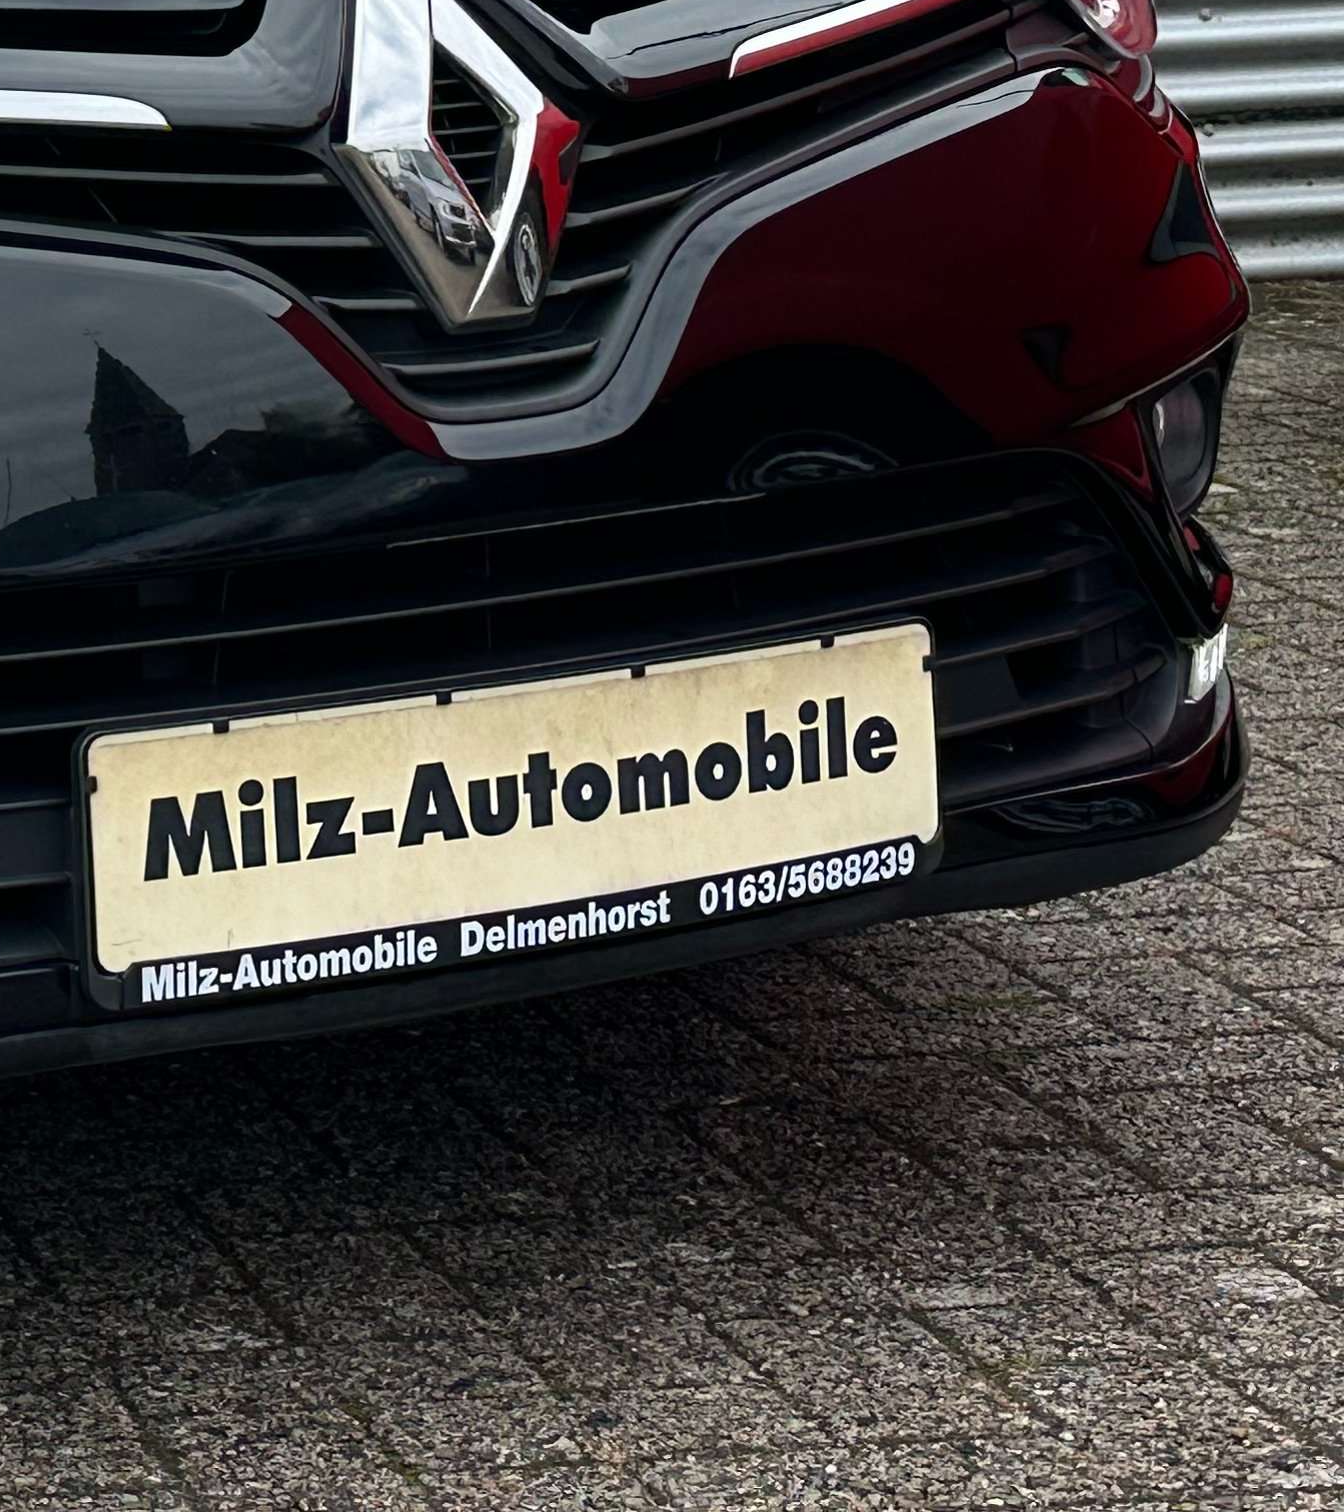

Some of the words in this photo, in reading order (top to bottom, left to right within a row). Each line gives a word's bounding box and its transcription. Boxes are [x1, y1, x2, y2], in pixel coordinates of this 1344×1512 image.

[143, 696, 898, 882] Milz-Automobile
[141, 930, 438, 1003] Milz-Automobile
[460, 890, 671, 957] Delmenhorst
[699, 843, 915, 915] 0163/5688239
